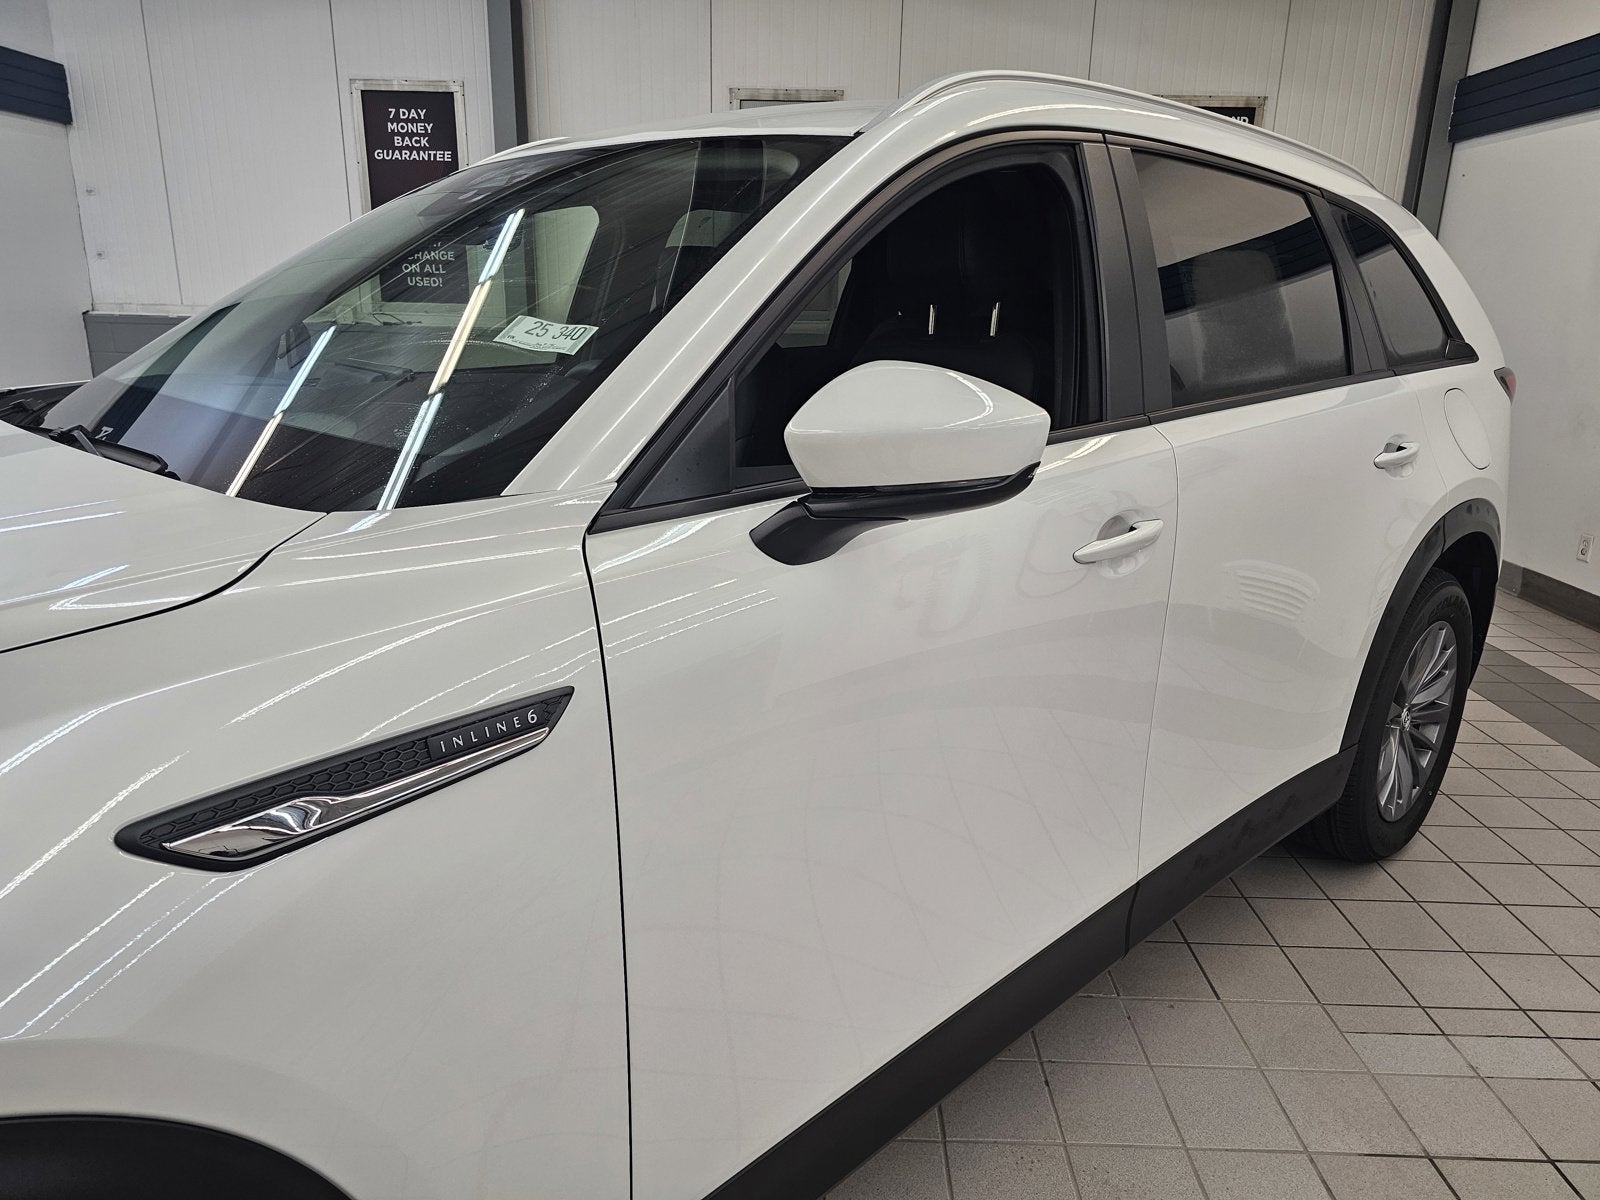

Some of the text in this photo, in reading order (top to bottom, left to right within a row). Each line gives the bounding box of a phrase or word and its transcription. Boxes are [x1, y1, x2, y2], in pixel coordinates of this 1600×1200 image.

[388, 108, 426, 119] 7 DAY
[387, 122, 433, 133] MONEY
[394, 136, 430, 147] BACK
[374, 149, 452, 161] GUARANTEE
[408, 251, 455, 261] HANGE
[402, 263, 446, 274] ON ALL
[407, 276, 443, 287] USED!
[524, 321, 588, 341] 25 340
